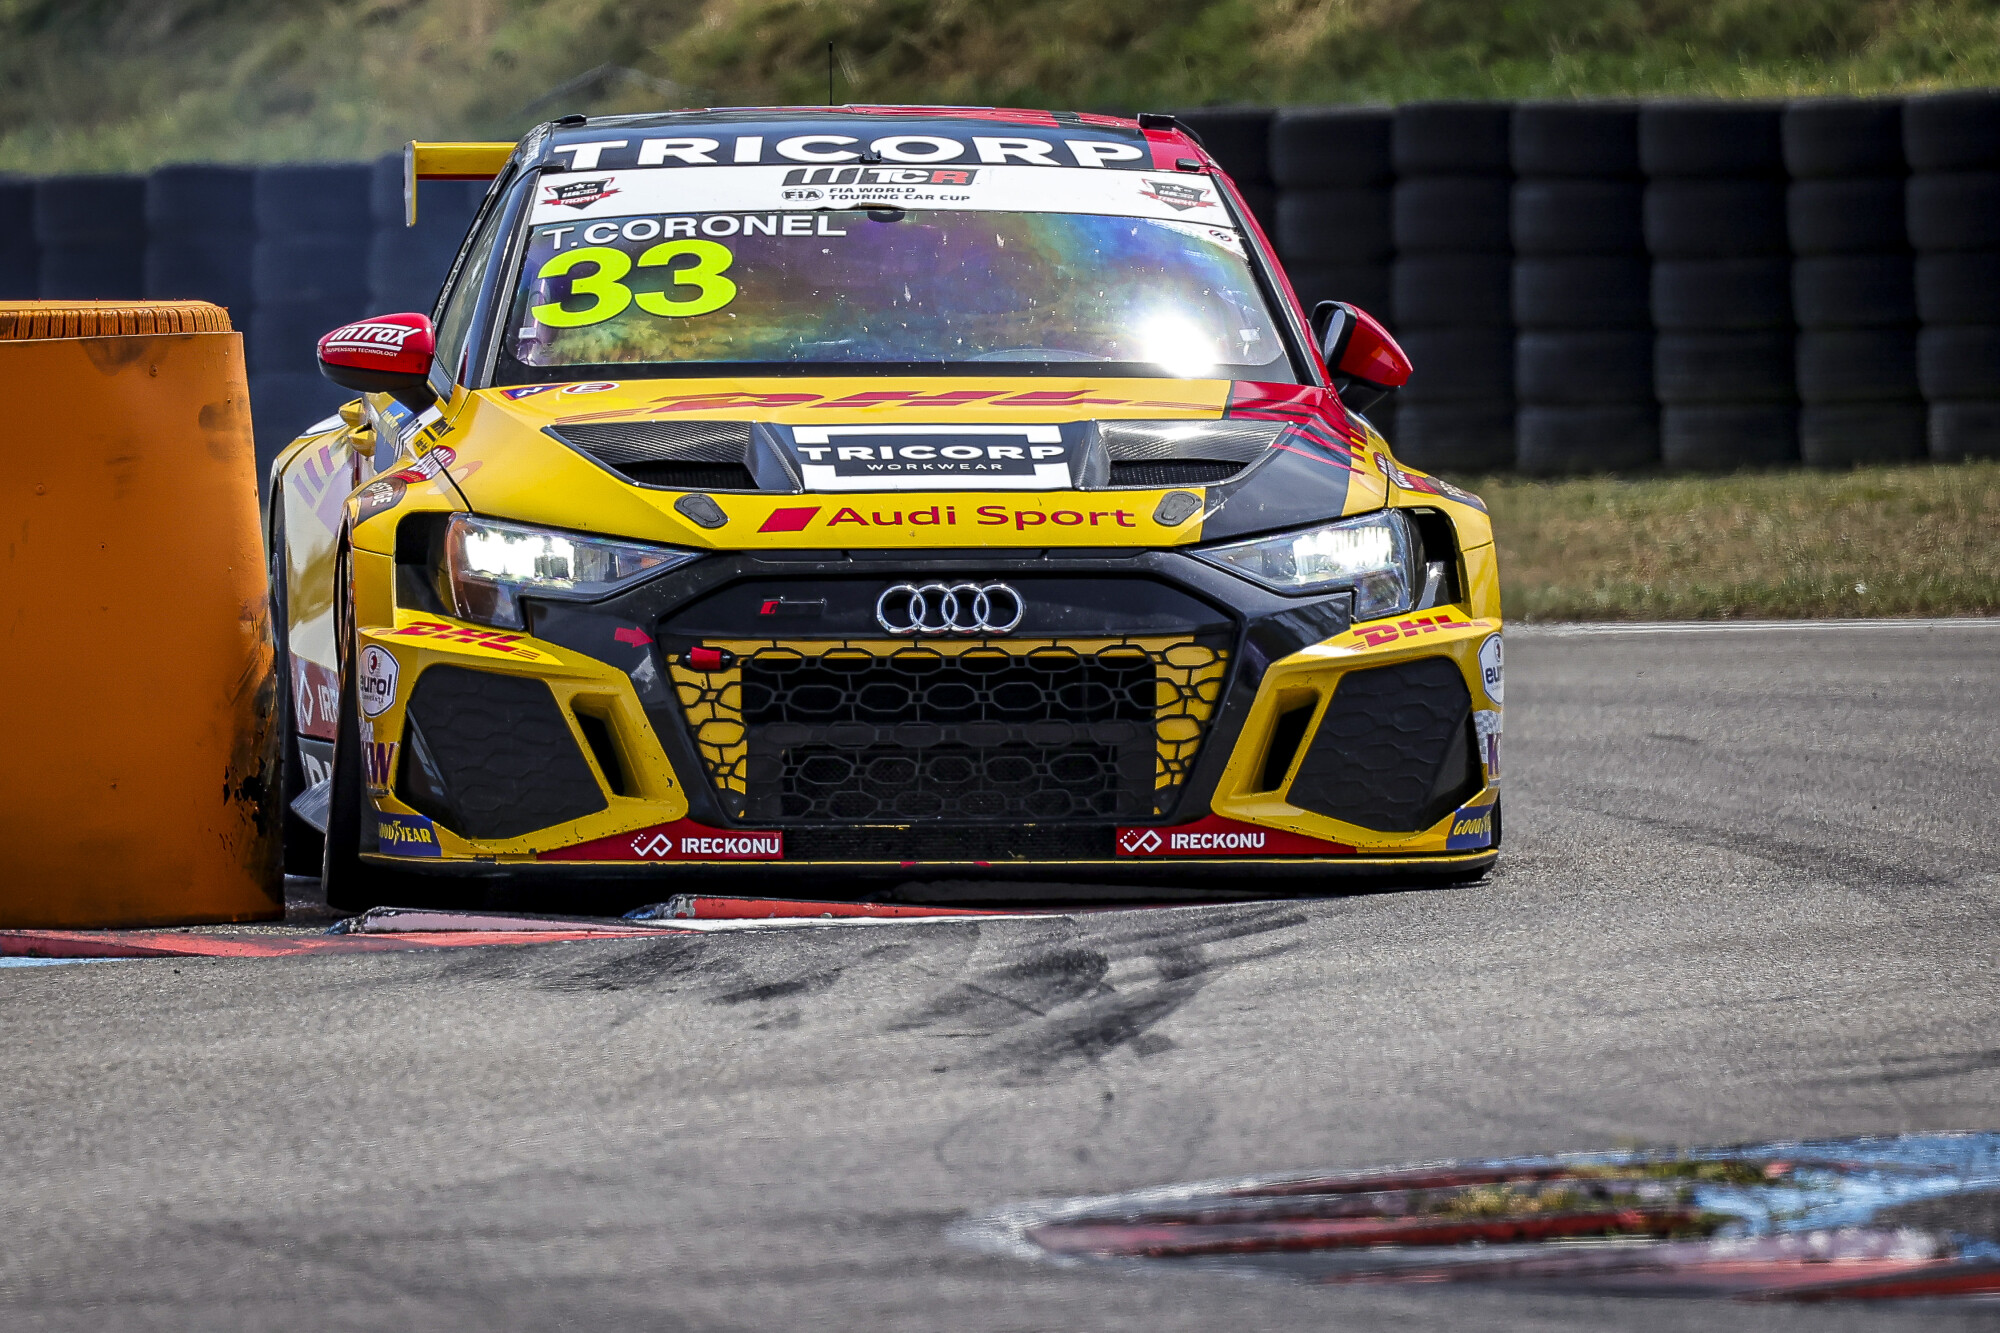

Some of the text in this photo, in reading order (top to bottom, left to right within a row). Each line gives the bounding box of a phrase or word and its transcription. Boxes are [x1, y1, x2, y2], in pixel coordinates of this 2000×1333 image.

[553, 135, 1143, 170] TRICORP
[542, 215, 847, 251] T.CORONEL
[531, 239, 737, 328] 33
[358, 348, 398, 357] TECHNOLOGY
[648, 389, 1131, 414] DHL
[797, 445, 1065, 461] TRICORP
[866, 463, 1003, 471] WORKWEAR
[826, 505, 1137, 531] Audi Sport
[396, 621, 526, 652] DHL
[1353, 615, 1472, 647] DHL
[681, 837, 780, 854] IRECKONU
[1170, 832, 1265, 849] IRECKONU
